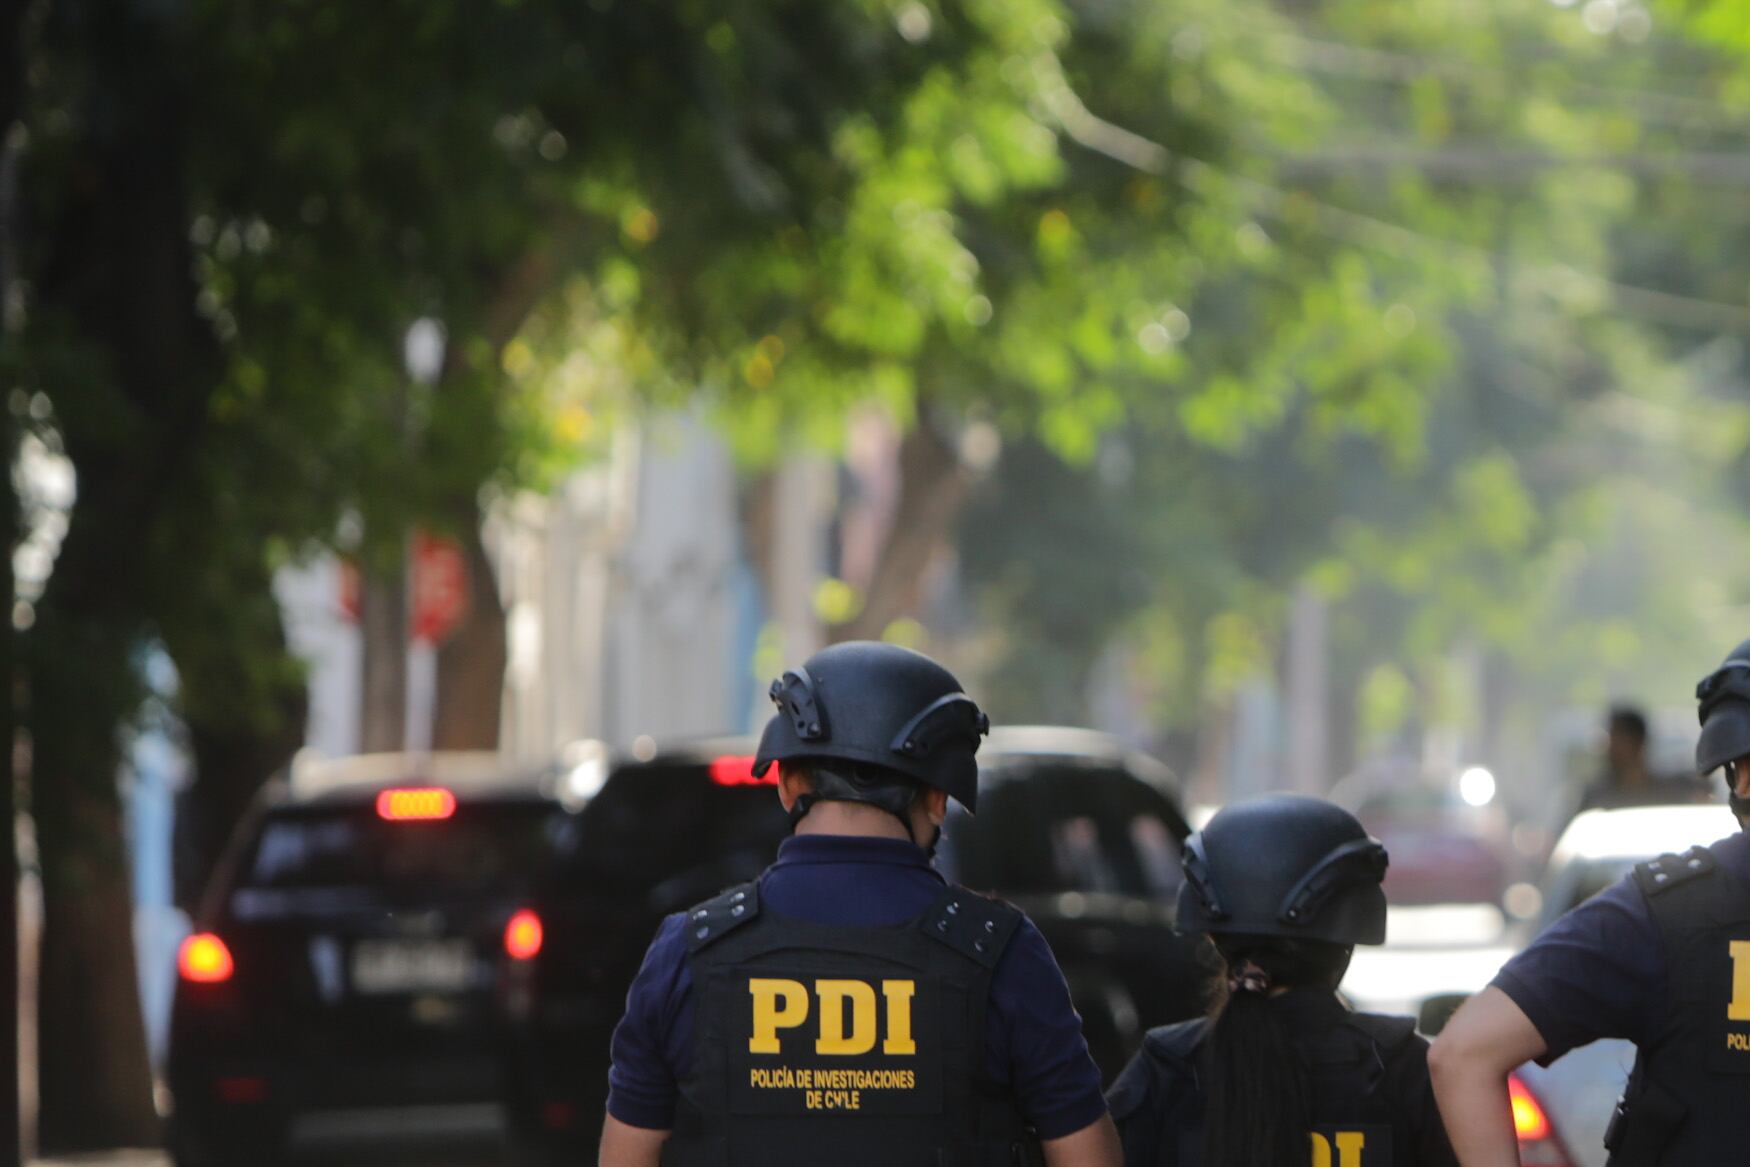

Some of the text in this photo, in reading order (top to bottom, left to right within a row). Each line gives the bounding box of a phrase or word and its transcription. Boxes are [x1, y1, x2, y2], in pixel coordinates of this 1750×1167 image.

[749, 978, 916, 1055] PDI
[751, 1066, 915, 1089] POLICÍA DE INVESTIGACIONES
[806, 1090, 822, 1109] DE
